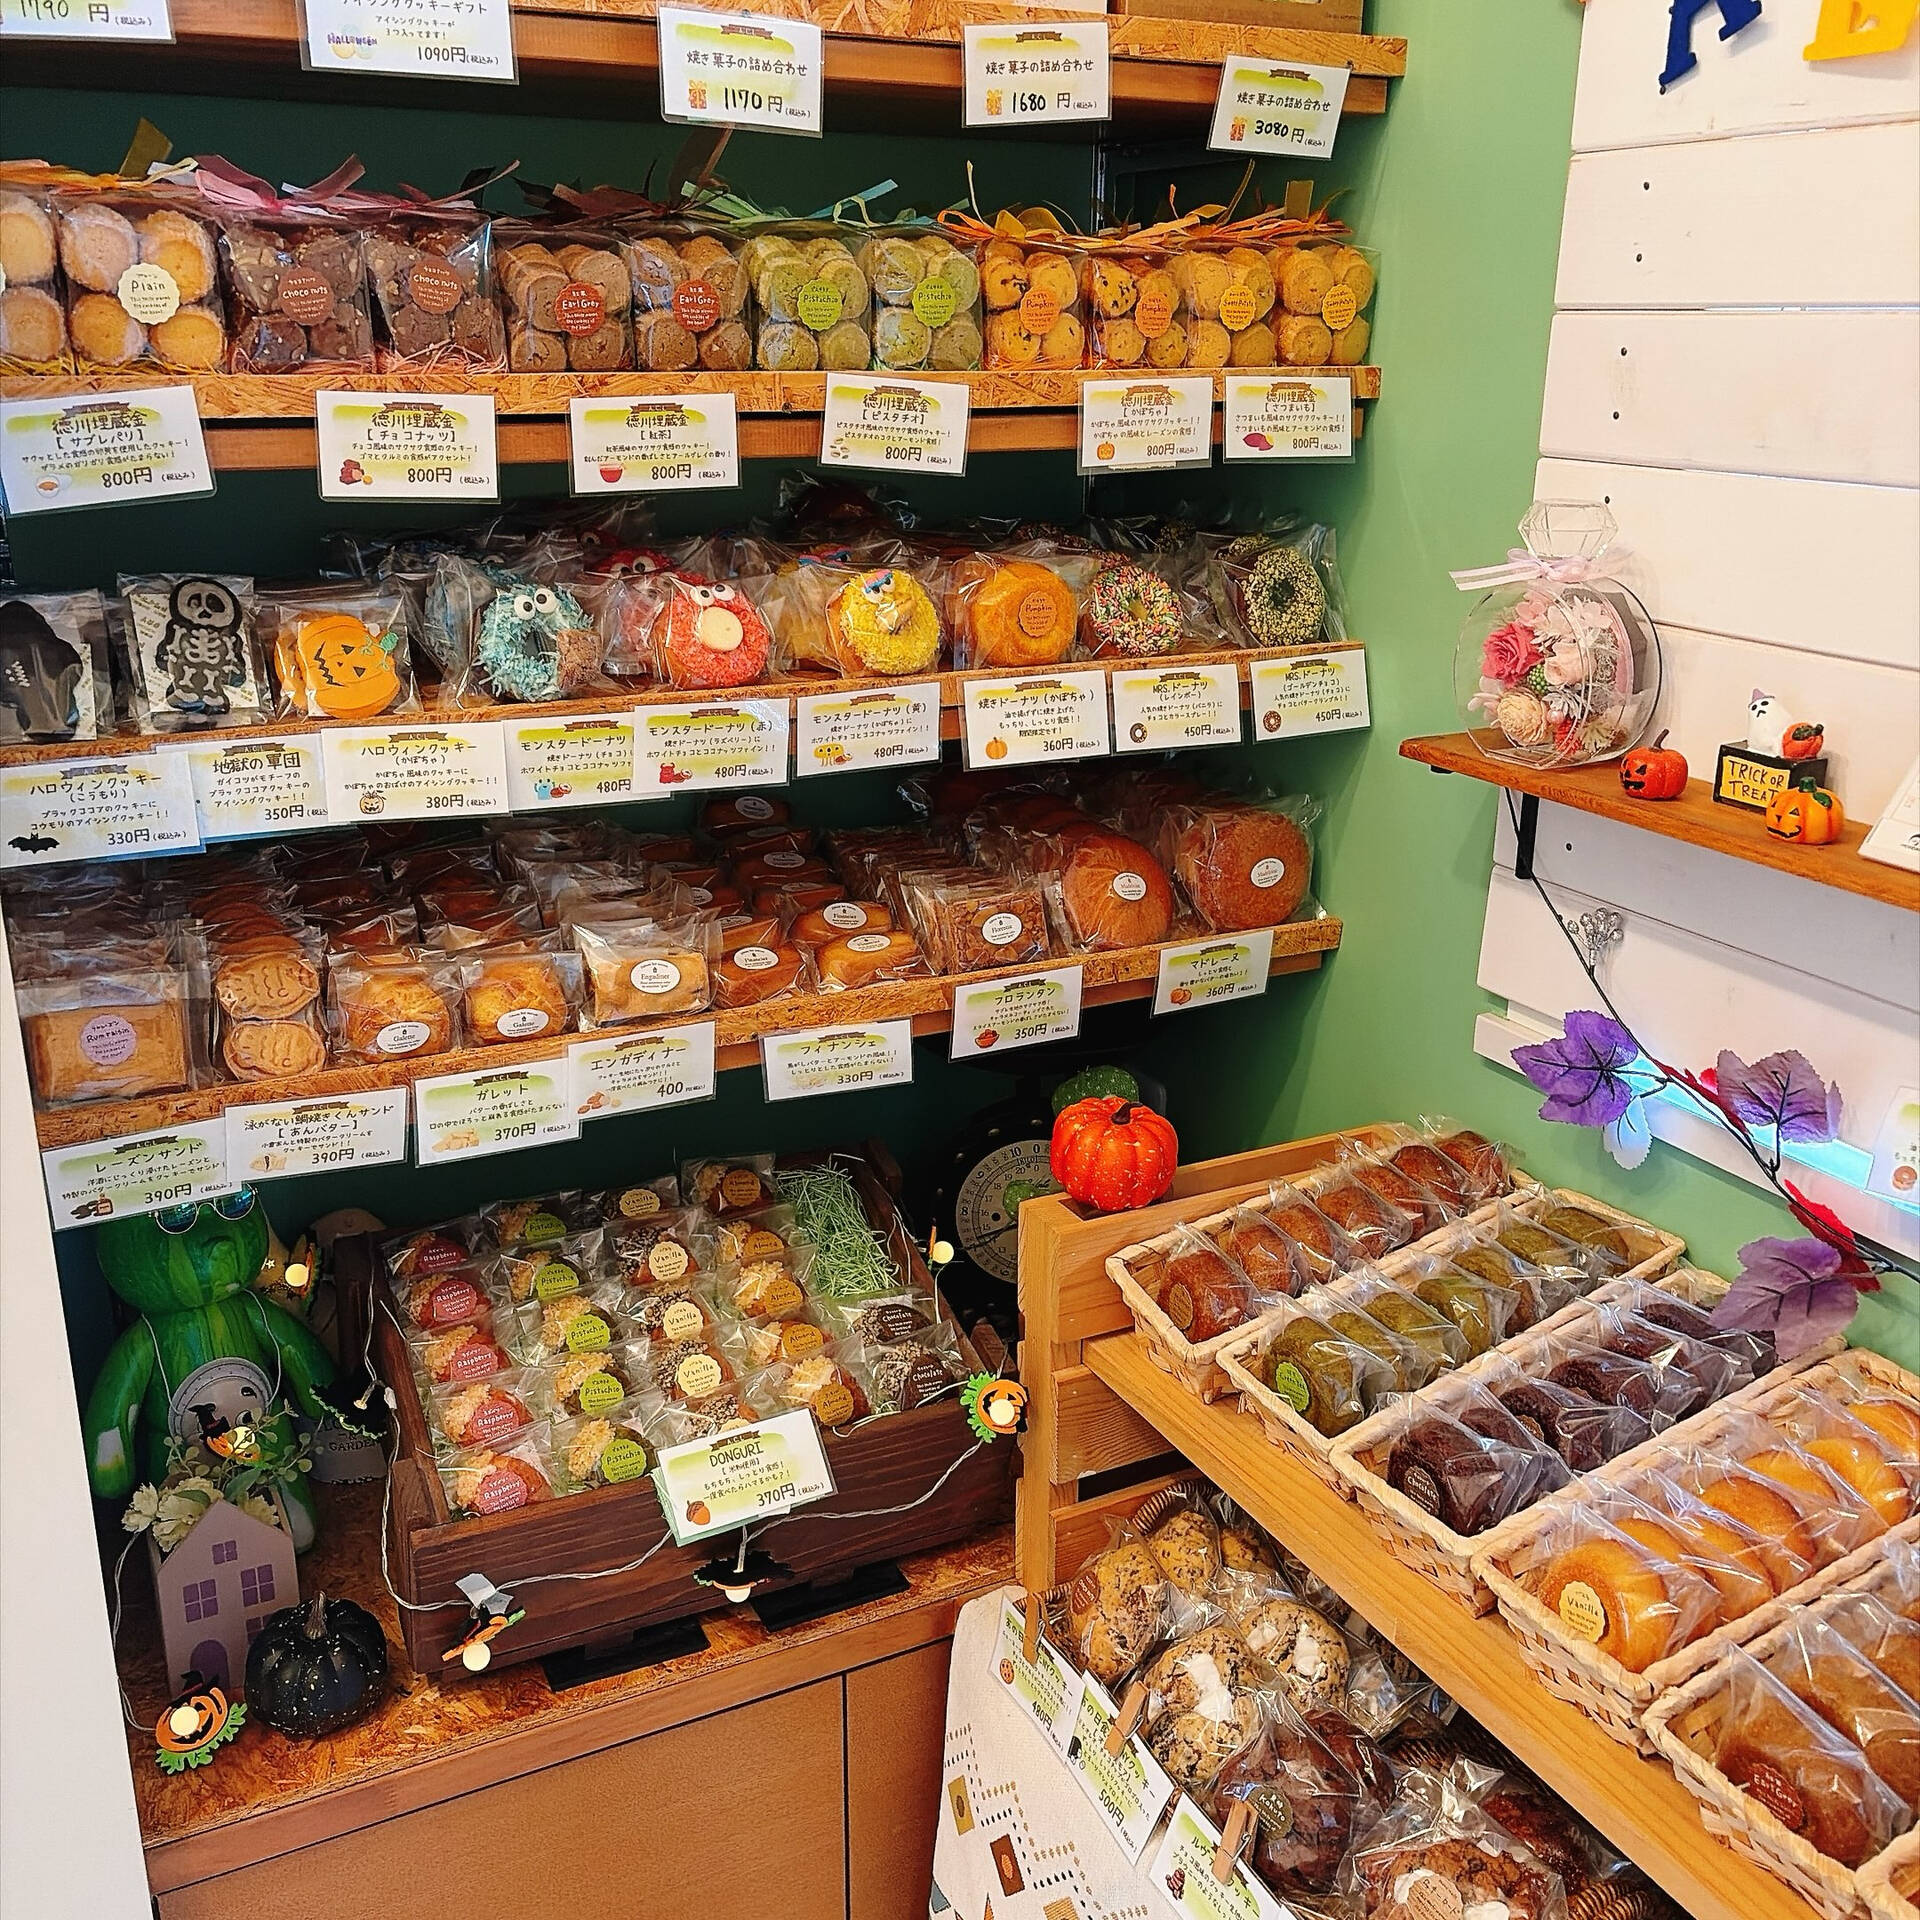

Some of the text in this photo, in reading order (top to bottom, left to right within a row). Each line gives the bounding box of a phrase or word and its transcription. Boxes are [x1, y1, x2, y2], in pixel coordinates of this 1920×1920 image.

[89, 3, 109, 23] 円
[418, 46, 465, 63] 1090円
[687, 50, 807, 76] 焼き菓子の詰め合わせ
[986, 58, 1094, 75] 焼き菓子の詰め合わせ
[724, 87, 762, 112] 1170
[768, 95, 782, 113] 円
[1012, 91, 1046, 114] 1680
[1057, 92, 1071, 109] 円
[1237, 92, 1331, 112] 焼き菓子の詰め合わせ
[1255, 120, 1304, 143] 3080 円
[131, 281, 166, 293] Plain
[1026, 300, 1054, 309] Pumpkin
[863, 394, 931, 413] 徳川埋蔵金
[1121, 393, 1175, 407] 徳川埋蔵金
[1266, 391, 1316, 403] 徳川埋蔵金
[1123, 407, 1168, 417] 【かぼちゃ】
[1265, 403, 1315, 412] 【さつまいも】
[52, 411, 147, 434] 徳川埋蔵金
[372, 412, 456, 429] 徳川埋蔵金
[626, 414, 689, 428] 徳川埋蔵金
[863, 409, 924, 424] 【ピスタチオ】
[56, 429, 144, 449] 【サブレパリ】
[367, 429, 455, 442] 【チョコナッツ】
[641, 430, 671, 440] 【紅茶】
[1293, 437, 1319, 449] 800円
[885, 446, 922, 462] 800円
[1147, 443, 1175, 456] 800円
[102, 467, 152, 488] 800円
[408, 467, 452, 483] 800円
[651, 464, 691, 480] 800円
[1303, 667, 1335, 679] ドーナツ
[1173, 681, 1208, 691] ドーナツ
[1159, 691, 1201, 702] (レインボー)
[1315, 709, 1341, 722] 450円
[1184, 724, 1211, 737] 450円
[361, 742, 478, 756] ハロウィンクッキー
[874, 744, 903, 758] 480円
[1043, 737, 1073, 752] 360円
[212, 752, 301, 774] 地獄の軍団
[395, 755, 445, 765] (かぼちゃ)
[217, 772, 300, 786] ガイコツがモチーフの
[714, 764, 746, 778] 480円
[1727, 759, 1785, 788] TRICK OR
[30, 773, 161, 795] ハロウィンクッキー
[209, 782, 310, 798] ブラックココアクッキーの
[597, 779, 631, 793] 480円
[1729, 780, 1780, 802] TREAT
[70, 789, 128, 803] (こうもり)
[214, 792, 305, 808] アイシングクッキー！！
[426, 794, 464, 809] 380円
[41, 801, 156, 818] ブラックココアのクッキーに
[265, 804, 304, 821] 350円
[108, 828, 150, 846] 330円
[1191, 952, 1239, 969] マドレーヌ
[995, 987, 1055, 1005] フロランタン
[1206, 983, 1235, 998] 360円
[1014, 1023, 1047, 1040] 350円
[801, 1039, 877, 1055] フィナンシェ
[591, 1046, 686, 1071] エンガディナー
[837, 1070, 873, 1085] 330円
[477, 1084, 529, 1102] ガレット
[657, 1081, 683, 1098] 400
[278, 1120, 358, 1139] 【あんバター】
[494, 1122, 536, 1141] 370円
[96, 1142, 202, 1173] レーズンサンド
[311, 1147, 354, 1165] 390円
[144, 1182, 192, 1204] 390円
[423, 1251, 457, 1262] Raspberry
[654, 1252, 682, 1264] Vanilla
[436, 1288, 471, 1302] Raspberry
[668, 1312, 697, 1325] Vanilla
[457, 1353, 492, 1368] Raspberry
[683, 1364, 714, 1378] Vanilla
[585, 1385, 621, 1396] Pistachio
[477, 1412, 515, 1427] Raspberry
[606, 1450, 641, 1465] Pistachio
[709, 1441, 764, 1467] DONGURI
[483, 1480, 521, 1501] Raspberry
[756, 1482, 795, 1507] 370円
[1568, 1596, 1598, 1616] Vanilla
[1030, 1698, 1053, 1731] 480円
[1098, 1785, 1124, 1829] 500円
[1259, 1794, 1286, 1822] Kokuto
